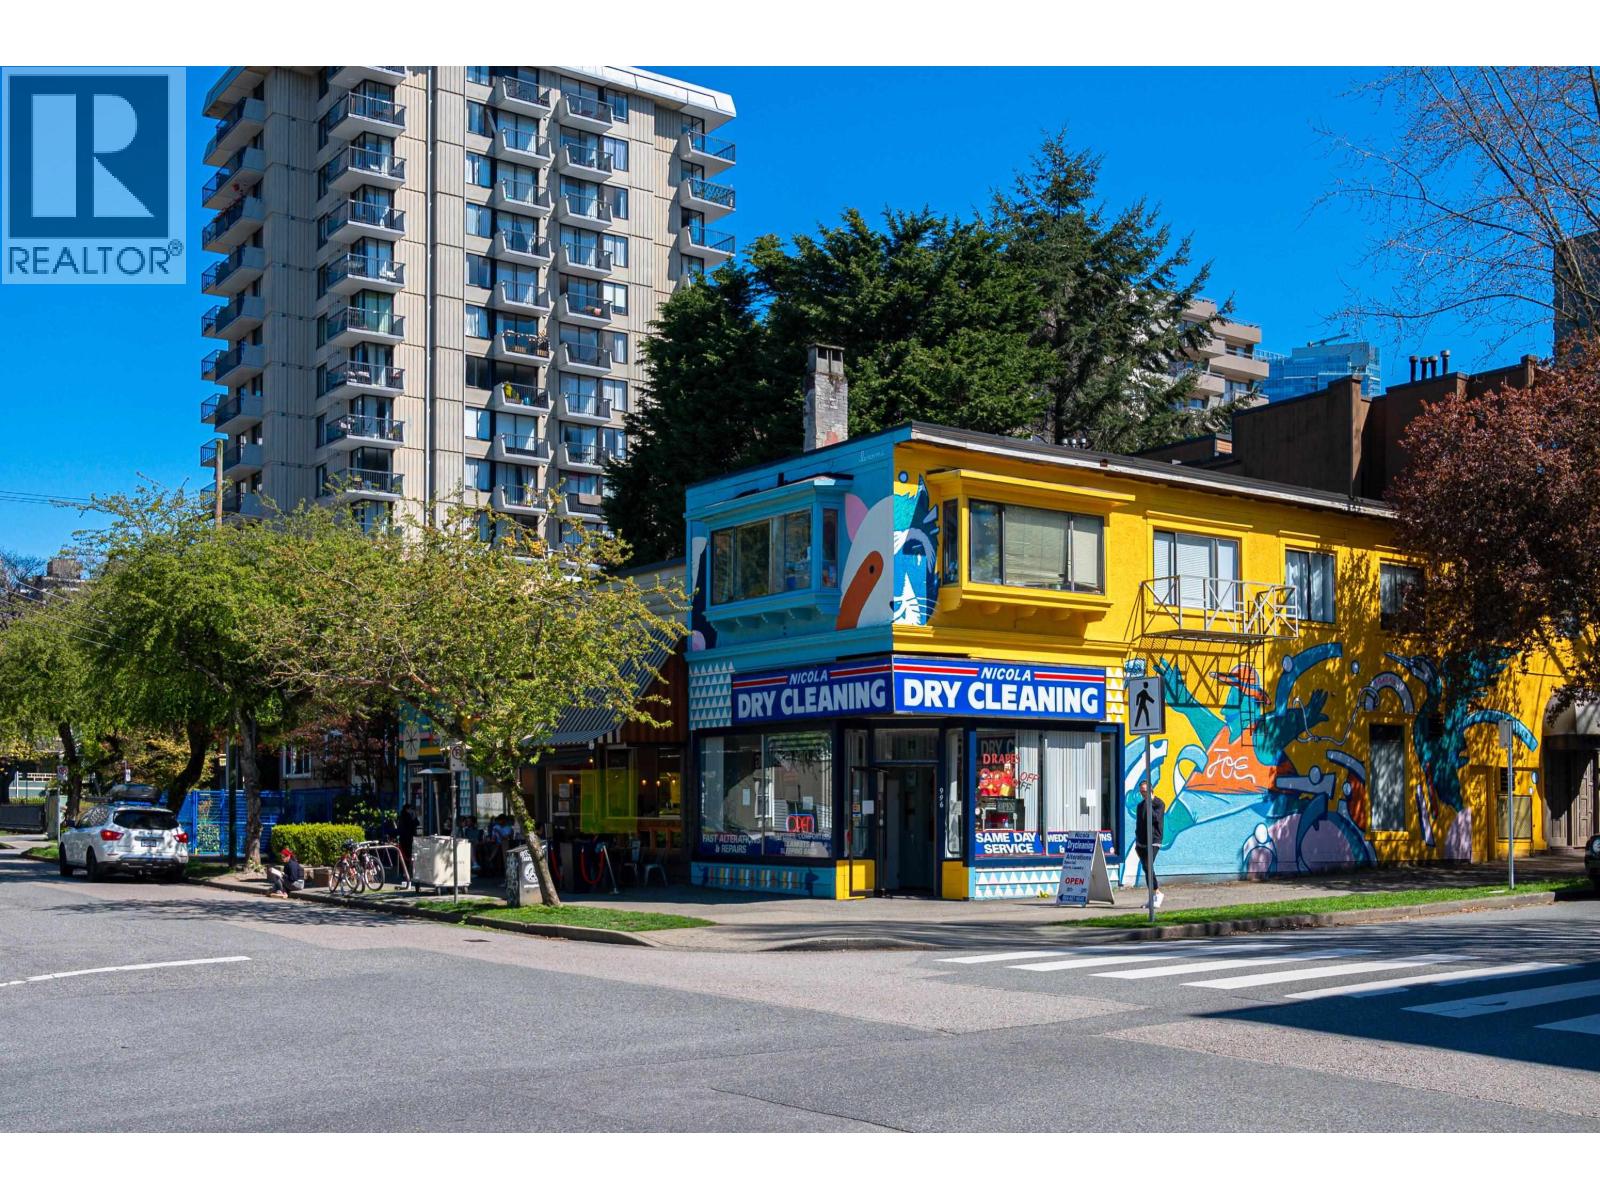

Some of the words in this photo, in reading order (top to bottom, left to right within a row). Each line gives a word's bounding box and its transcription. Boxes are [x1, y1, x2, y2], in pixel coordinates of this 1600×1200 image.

[788, 669, 829, 685] NICOLA
[980, 667, 1032, 682] NICOLA
[738, 690, 777, 719] DRY
[780, 679, 886, 716] CLEANING
[903, 678, 962, 708] DRY
[967, 681, 1099, 714] CLEANING
[702, 834, 718, 843] FAST
[975, 832, 1011, 843] SAME
[1013, 831, 1037, 843] DAY
[721, 845, 747, 854] REPAIRS
[984, 843, 1034, 854] SERVICE
[1065, 876, 1085, 886] OPEN
